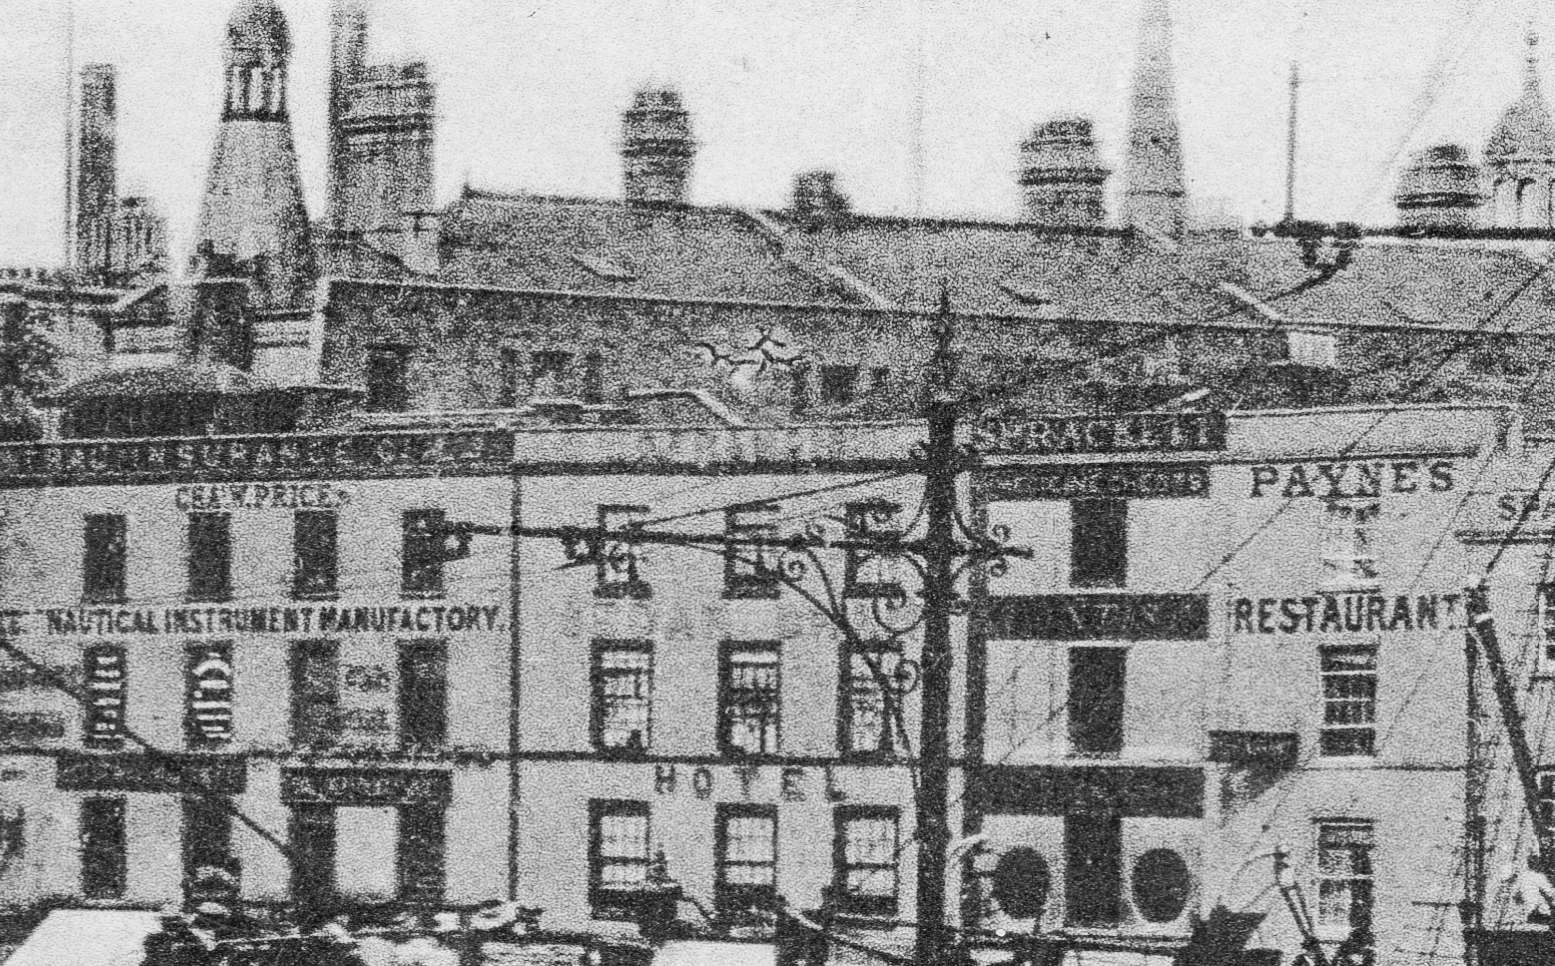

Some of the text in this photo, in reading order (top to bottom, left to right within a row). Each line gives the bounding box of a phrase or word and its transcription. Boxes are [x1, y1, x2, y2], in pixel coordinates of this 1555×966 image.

[48, 607, 160, 636] NAUTICAL
[164, 605, 314, 635] INSTRUMENT
[1233, 594, 1462, 634] RESTAURANT
[654, 763, 847, 802] HOTEL
